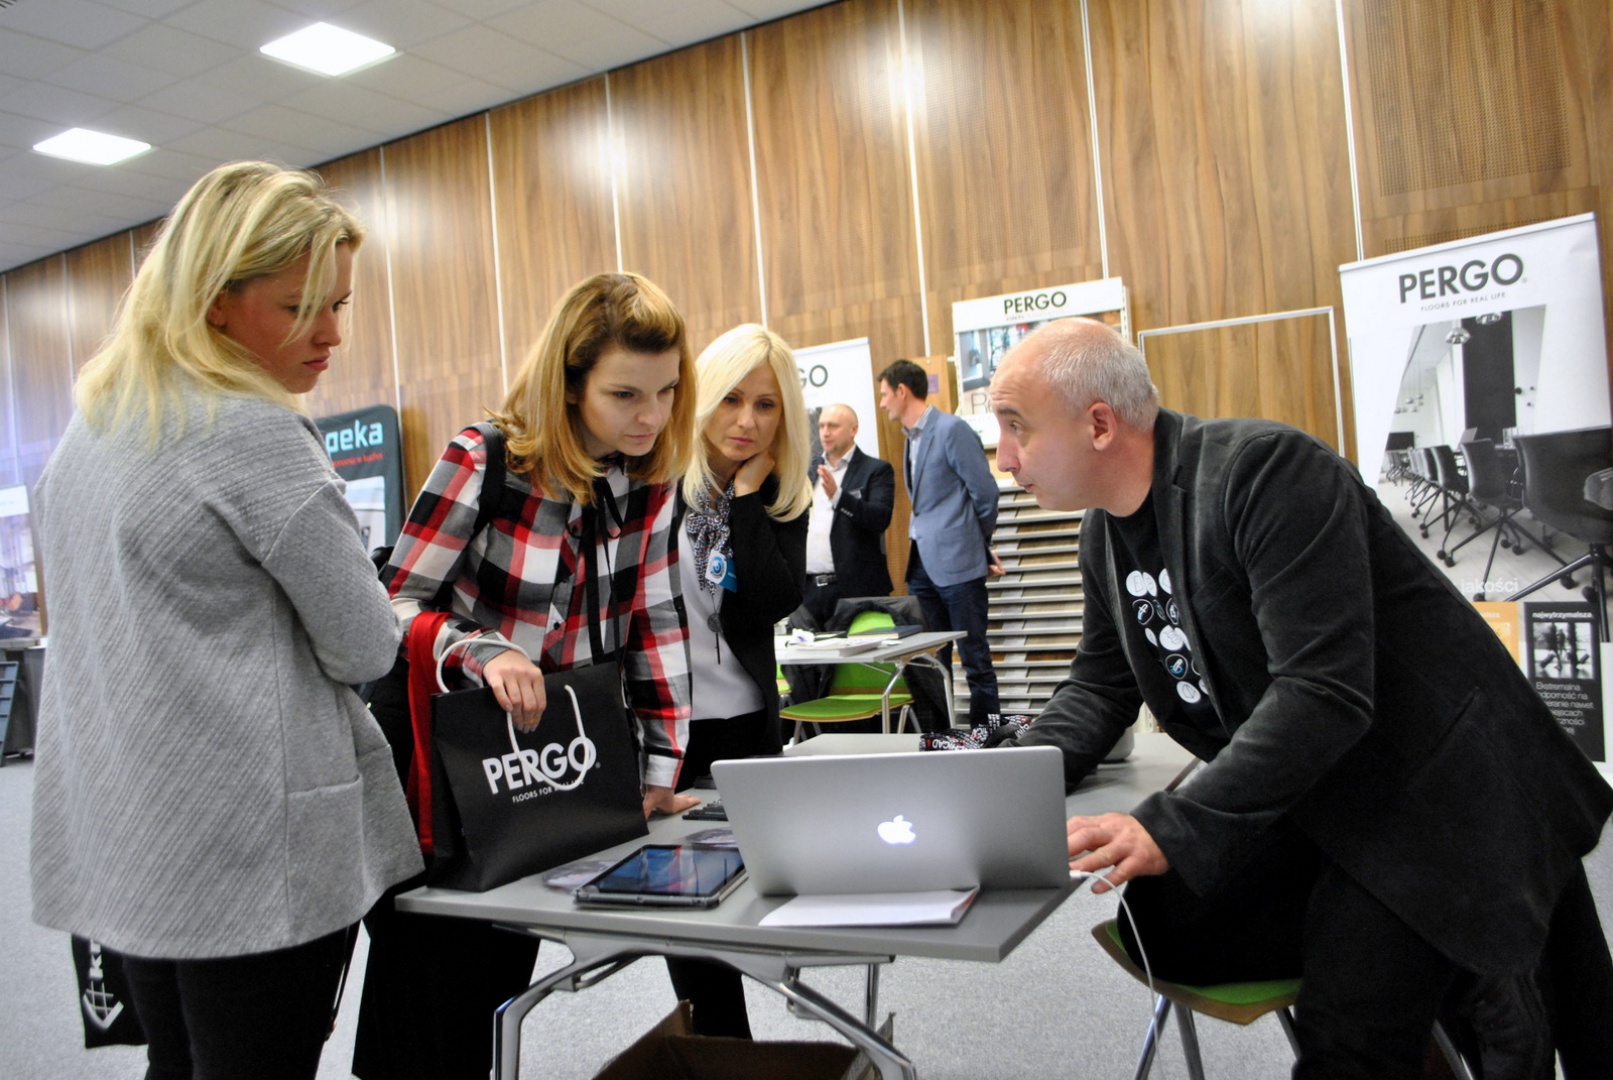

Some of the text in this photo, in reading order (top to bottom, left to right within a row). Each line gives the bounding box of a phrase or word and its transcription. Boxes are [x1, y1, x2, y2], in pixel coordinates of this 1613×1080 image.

[1399, 253, 1524, 304] PERGO
[1003, 291, 1067, 314] PERGO
[1421, 292, 1506, 311] FLOORS FOR REAL LIFE
[1460, 577, 1518, 595] jakości
[482, 736, 597, 795] PERGO
[512, 786, 553, 803] FLOORS FOR
